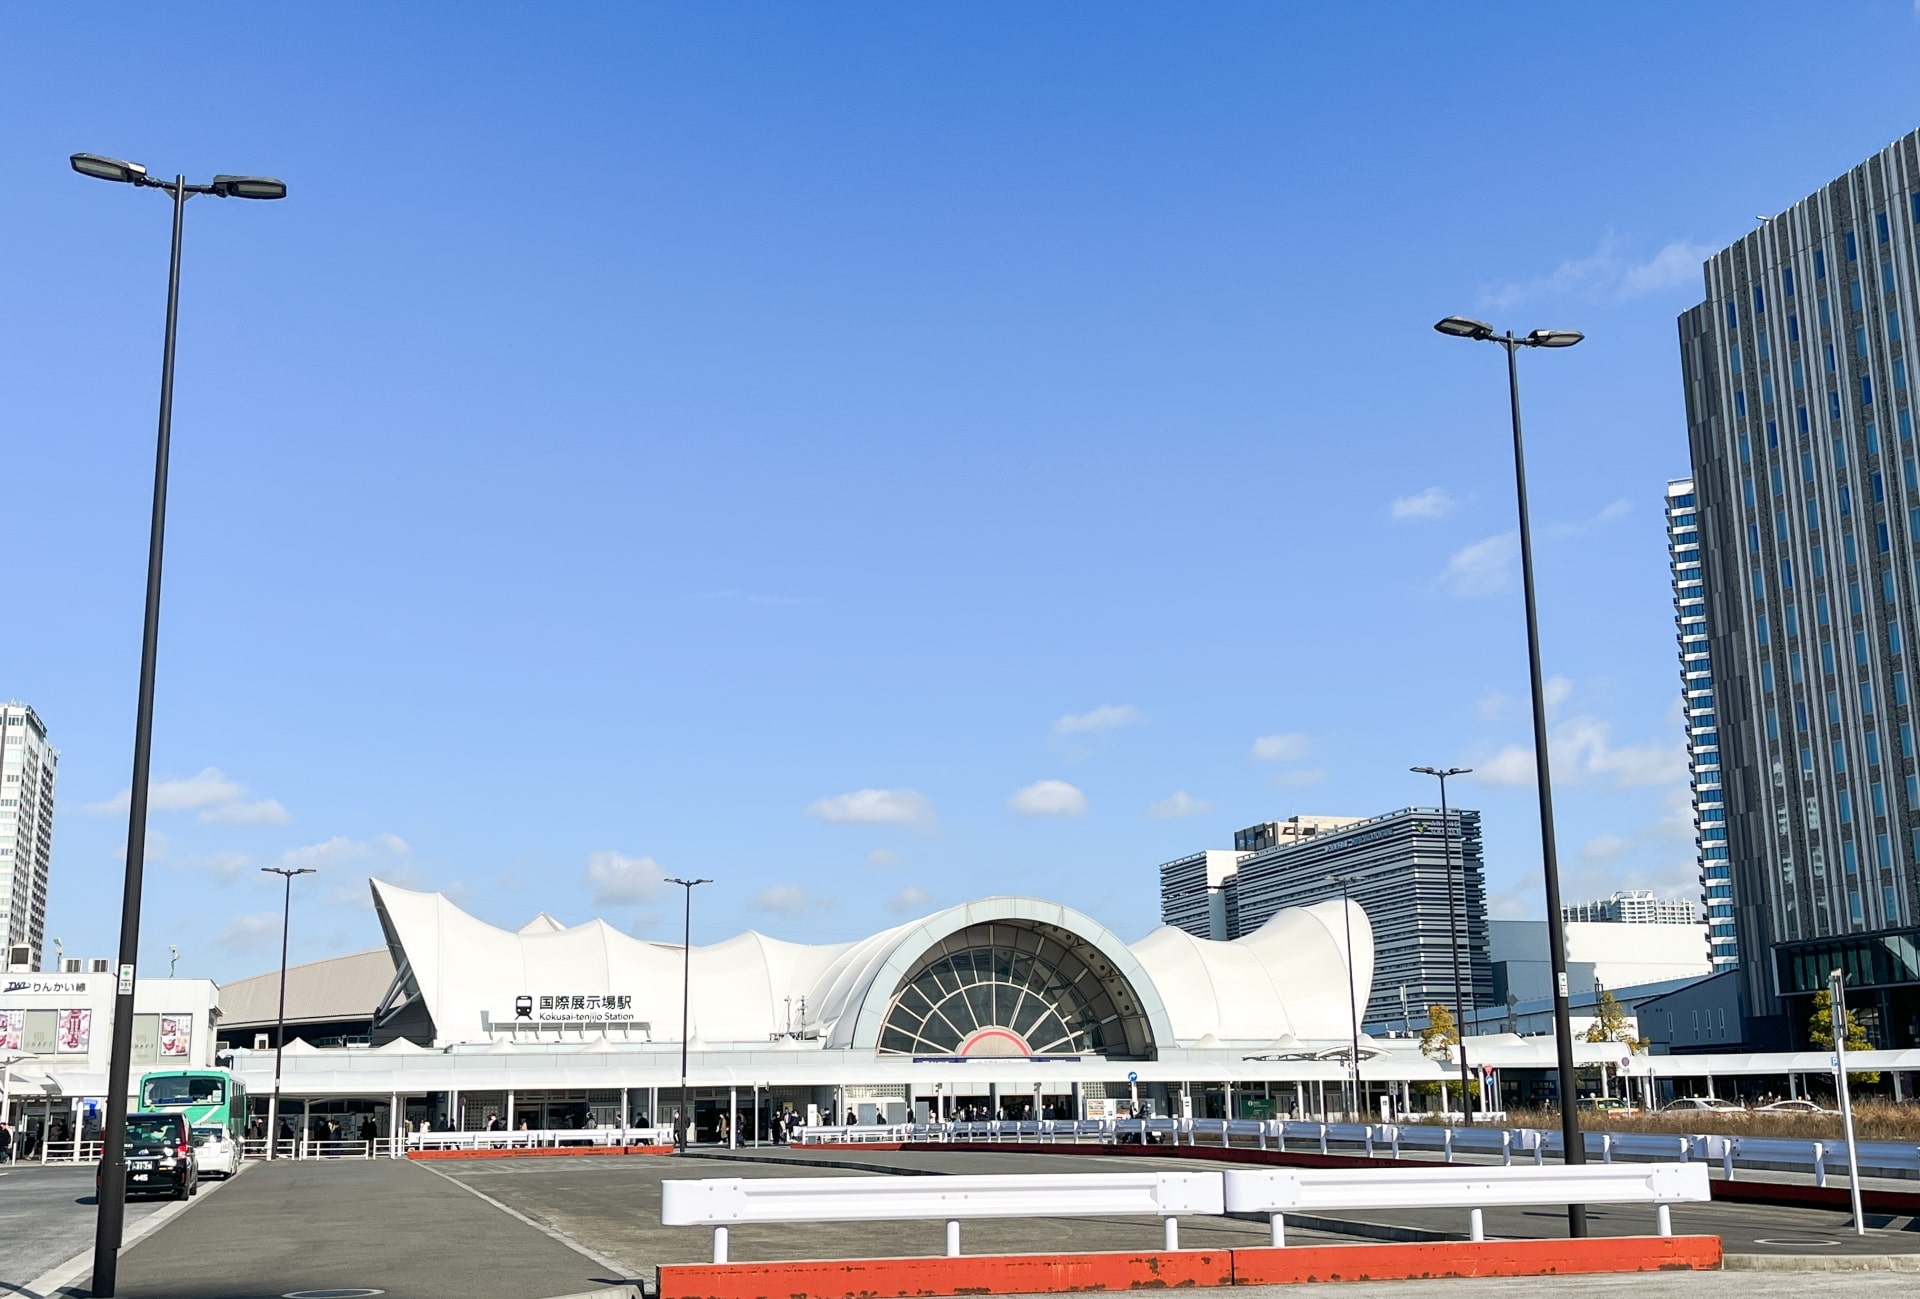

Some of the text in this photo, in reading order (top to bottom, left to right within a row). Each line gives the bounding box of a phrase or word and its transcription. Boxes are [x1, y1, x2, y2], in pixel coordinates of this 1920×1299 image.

[33, 982, 86, 992] りんかい線
[539, 995, 632, 1010] 国際展示場駅
[539, 1011, 634, 1023] Kokusai-tenjijo Station
